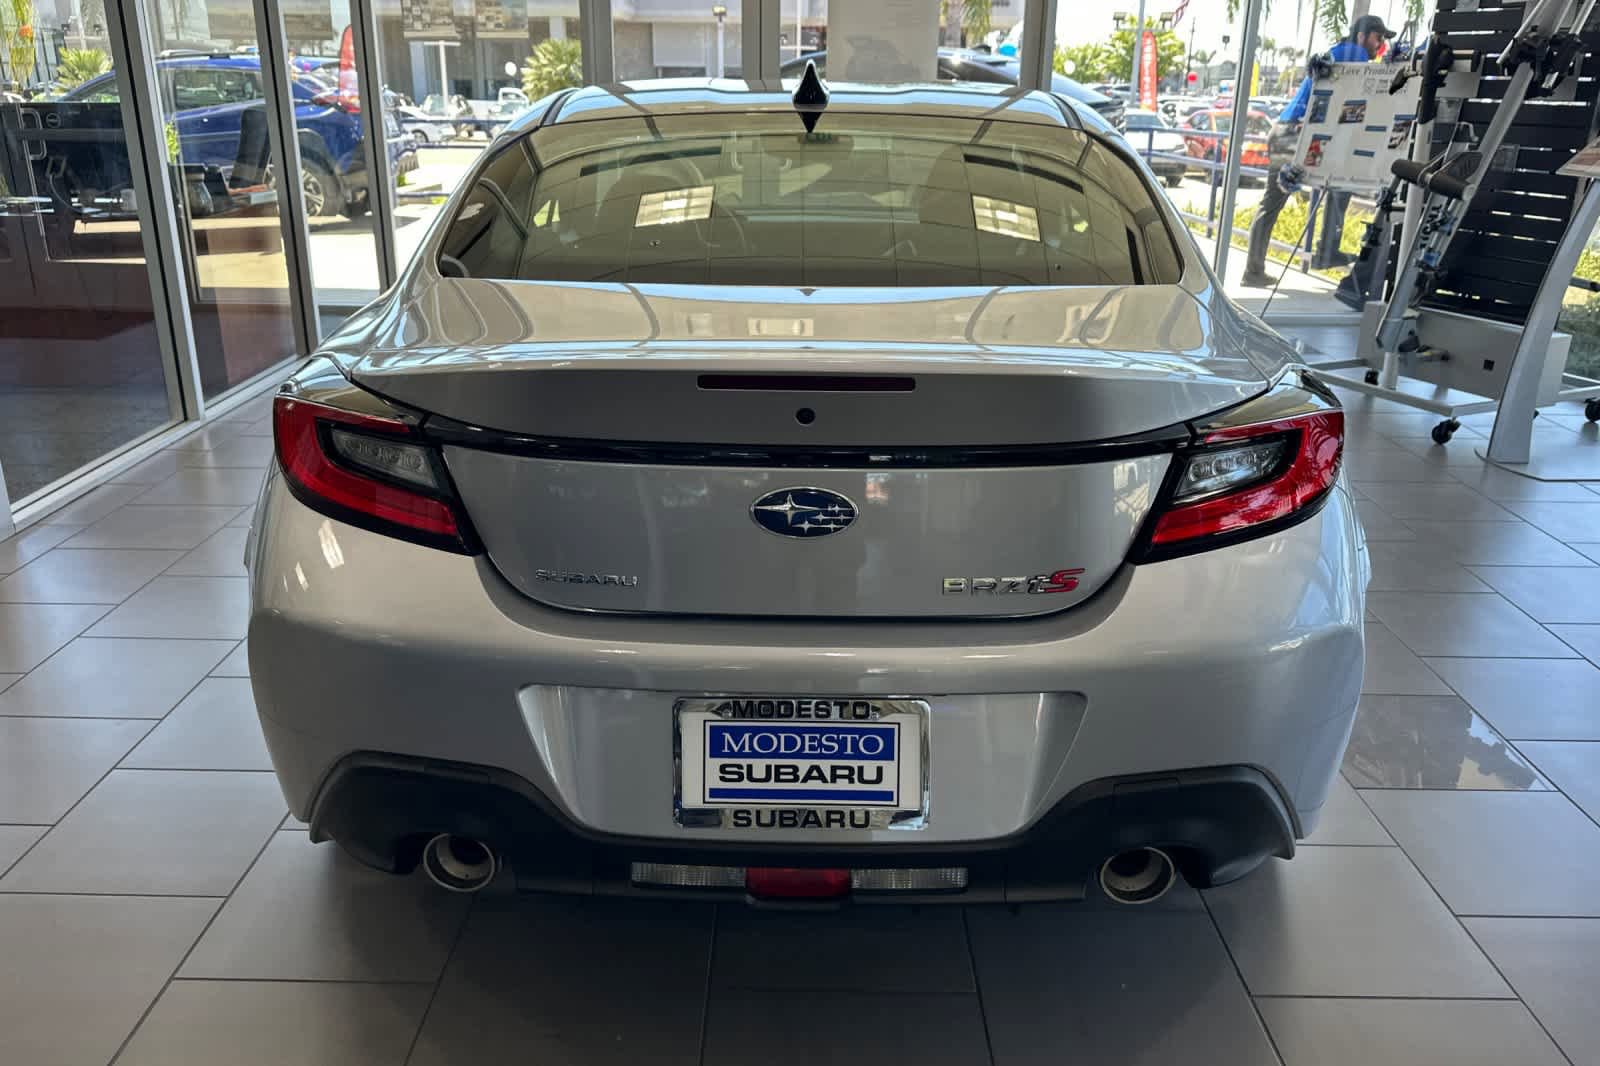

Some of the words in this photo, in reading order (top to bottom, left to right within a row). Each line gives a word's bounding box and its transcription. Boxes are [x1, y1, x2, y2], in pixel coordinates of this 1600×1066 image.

[535, 568, 639, 587] SUBARU
[733, 700, 871, 719] MODESTO
[722, 732, 885, 755] MODESTO
[718, 763, 884, 785] SUBARU
[733, 809, 870, 829] SUBARU
